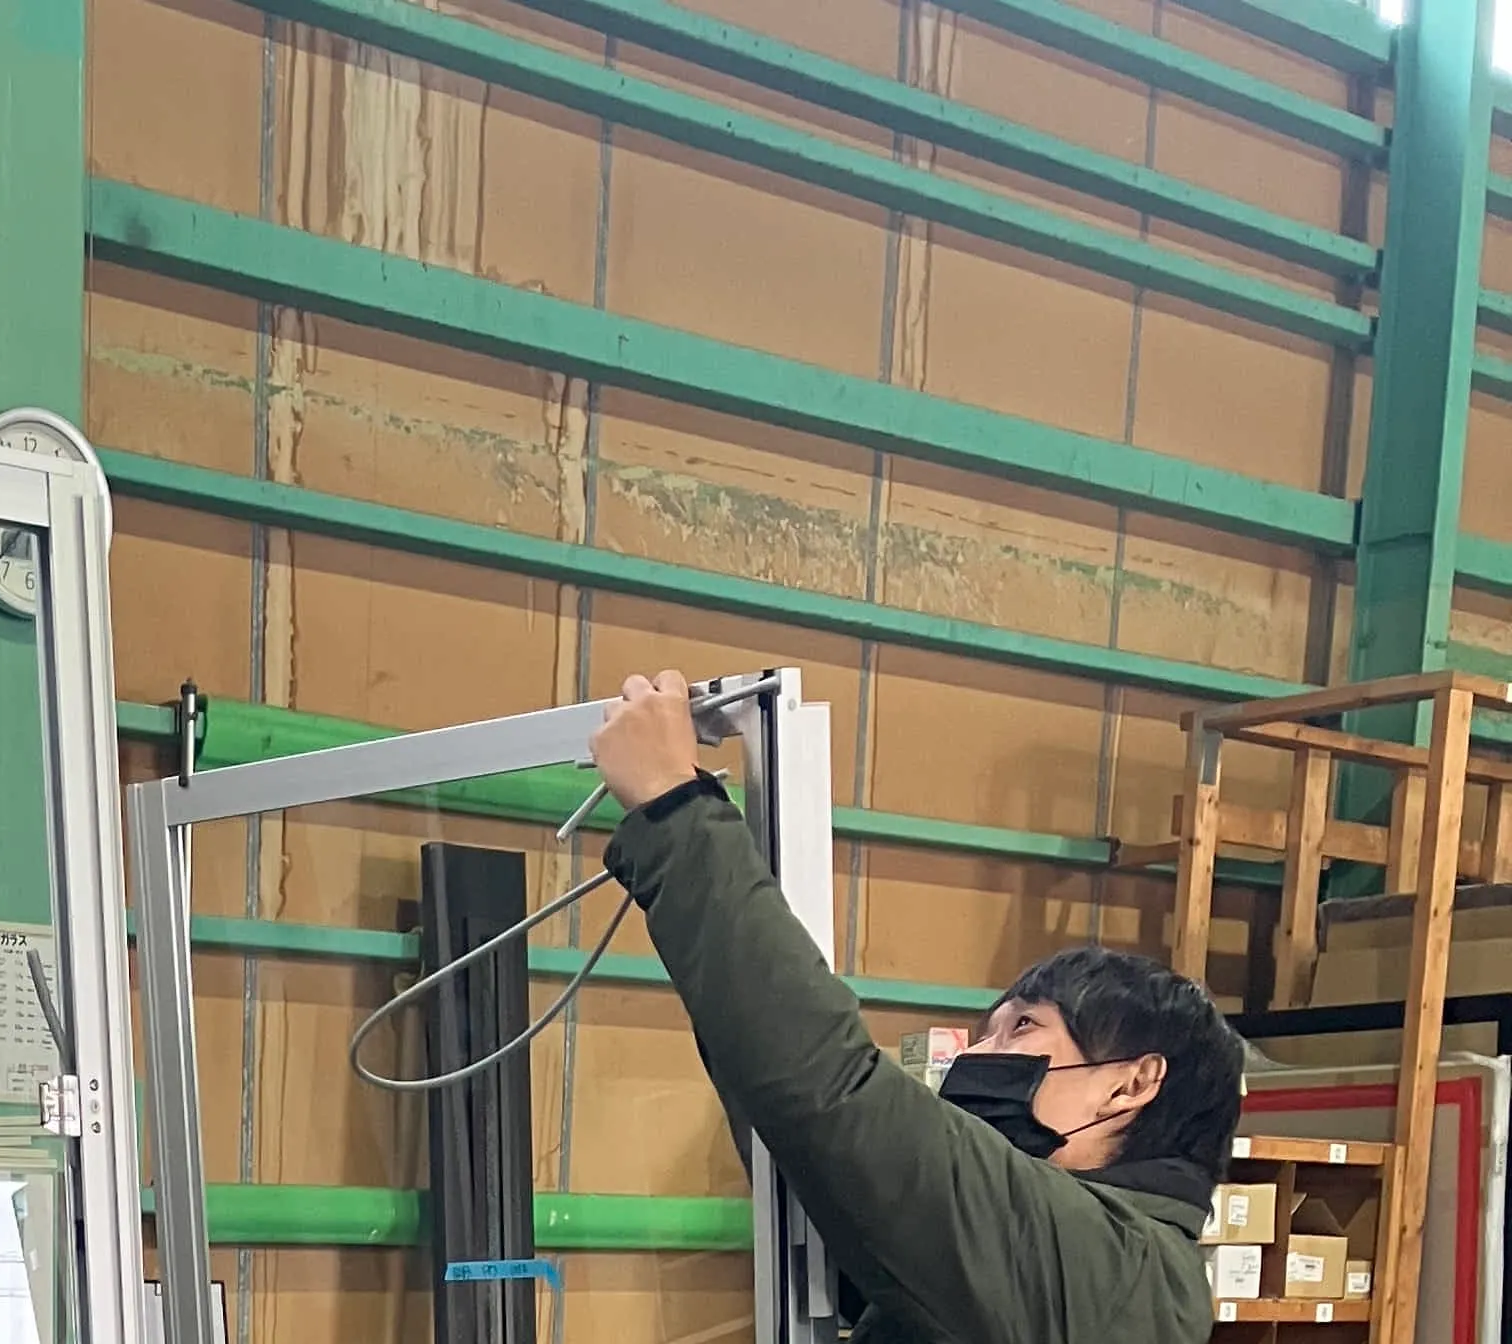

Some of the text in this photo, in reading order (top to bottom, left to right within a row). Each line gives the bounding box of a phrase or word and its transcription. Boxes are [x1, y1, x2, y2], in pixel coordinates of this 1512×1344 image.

[2, 561, 11, 581] 7
[24, 571, 35, 590] 6
[0, 933, 28, 947] ガラス
